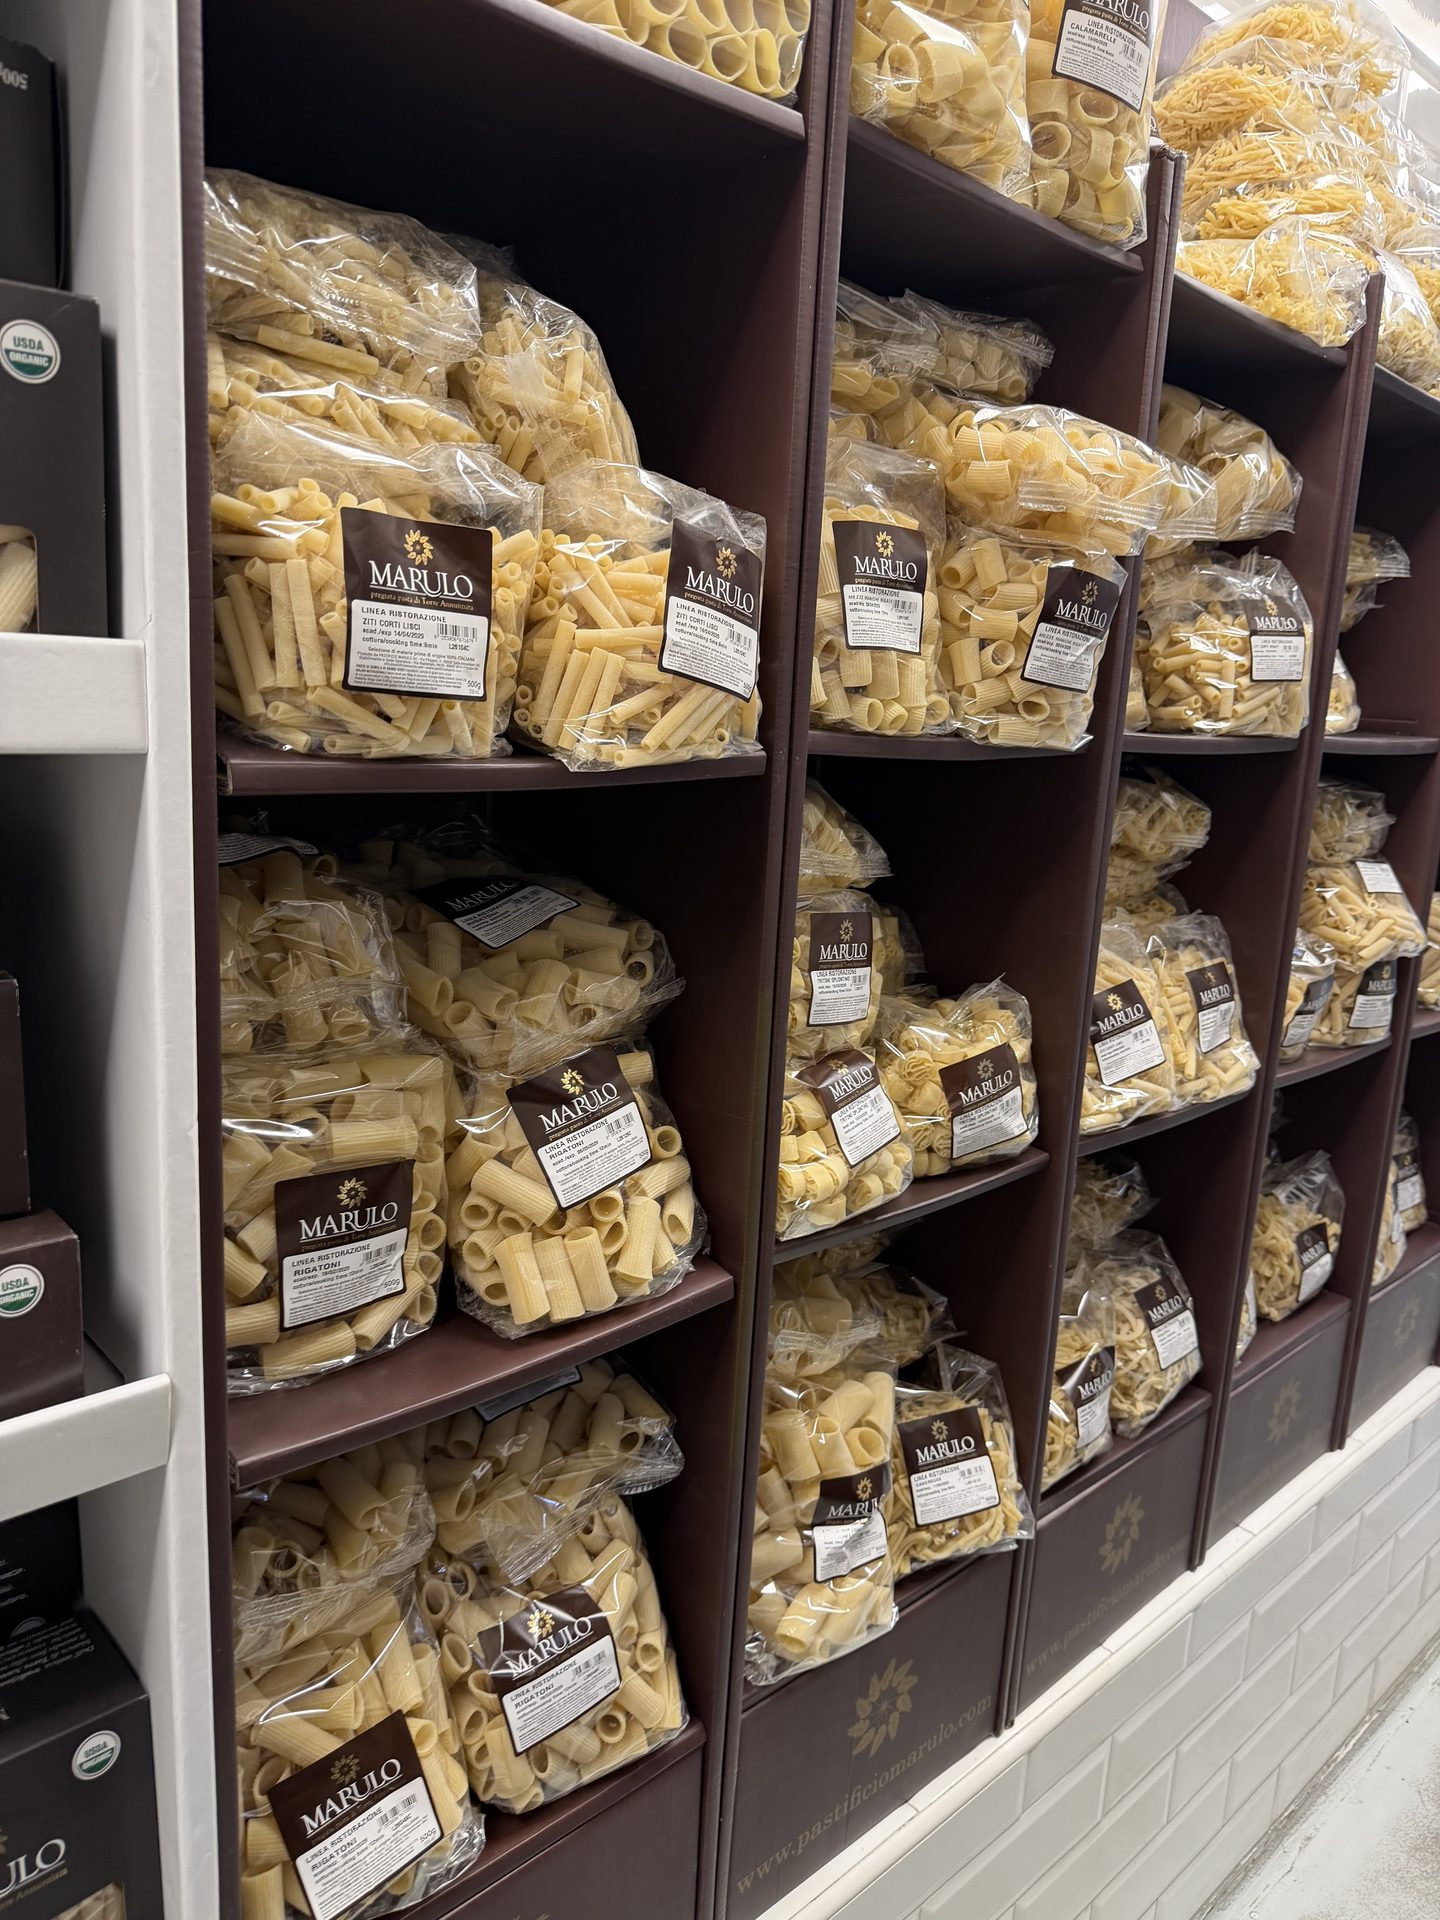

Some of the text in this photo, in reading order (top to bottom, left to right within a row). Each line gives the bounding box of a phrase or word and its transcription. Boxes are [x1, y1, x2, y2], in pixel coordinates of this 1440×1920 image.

[1083, 0, 1149, 30] RULO
[1070, 22, 1117, 44] CALAMARELLE
[1087, 19, 1137, 48] LINEA RISTORAZIONE
[13, 336, 44, 352] USDA
[9, 351, 49, 367] ORGANIC
[368, 560, 474, 598] MARULO
[853, 555, 917, 580] MARULO
[686, 566, 754, 613] MARULO
[868, 587, 900, 598] RISTORAZIONE
[361, 606, 447, 623] LINEA RISTORAZIONE
[362, 617, 421, 631] ZITI CORTI LISCI
[676, 603, 735, 629] LINEA RISTORAZIONE
[676, 612, 719, 631] ZITI CORTI LISCI
[1056, 599, 1107, 628] MARULO
[1254, 616, 1298, 631] MARULO
[1045, 626, 1061, 635] LINEA
[467, 680, 481, 690] 500g
[820, 943, 868, 960] MARULO
[1096, 1003, 1144, 1033] MARULO
[829, 1066, 872, 1100] MARULO
[959, 1069, 1013, 1105] MARULO
[538, 1082, 618, 1132] MARULO
[544, 1118, 609, 1154] LINEA RISTORAZIONE
[549, 1140, 585, 1160] RIGATONI
[299, 1202, 399, 1241] MARULO
[292, 1243, 371, 1267] LINEA RISTORAZIONE
[293, 1261, 341, 1277] RIGATONI
[2, 1277, 30, 1291] USDA
[384, 1279, 400, 1288] 500g
[1148, 1295, 1182, 1322] MARULO
[1077, 1370, 1112, 1400] MARULO
[915, 1436, 976, 1463] MARULO
[928, 1465, 960, 1478] RISTORAZIONE
[505, 1617, 592, 1677] MARULO
[510, 1660, 578, 1702] LINEA RISTORAZIONE
[514, 1683, 555, 1709] RIGATONI
[300, 1758, 401, 1836] MARULO
[736, 1695, 992, 1895] www.pastificiomarulo.com
[305, 1806, 383, 1864] LINEA RISTORAZIONE
[420, 1828, 437, 1843] 500g
[311, 1837, 358, 1872] RIGATONI
